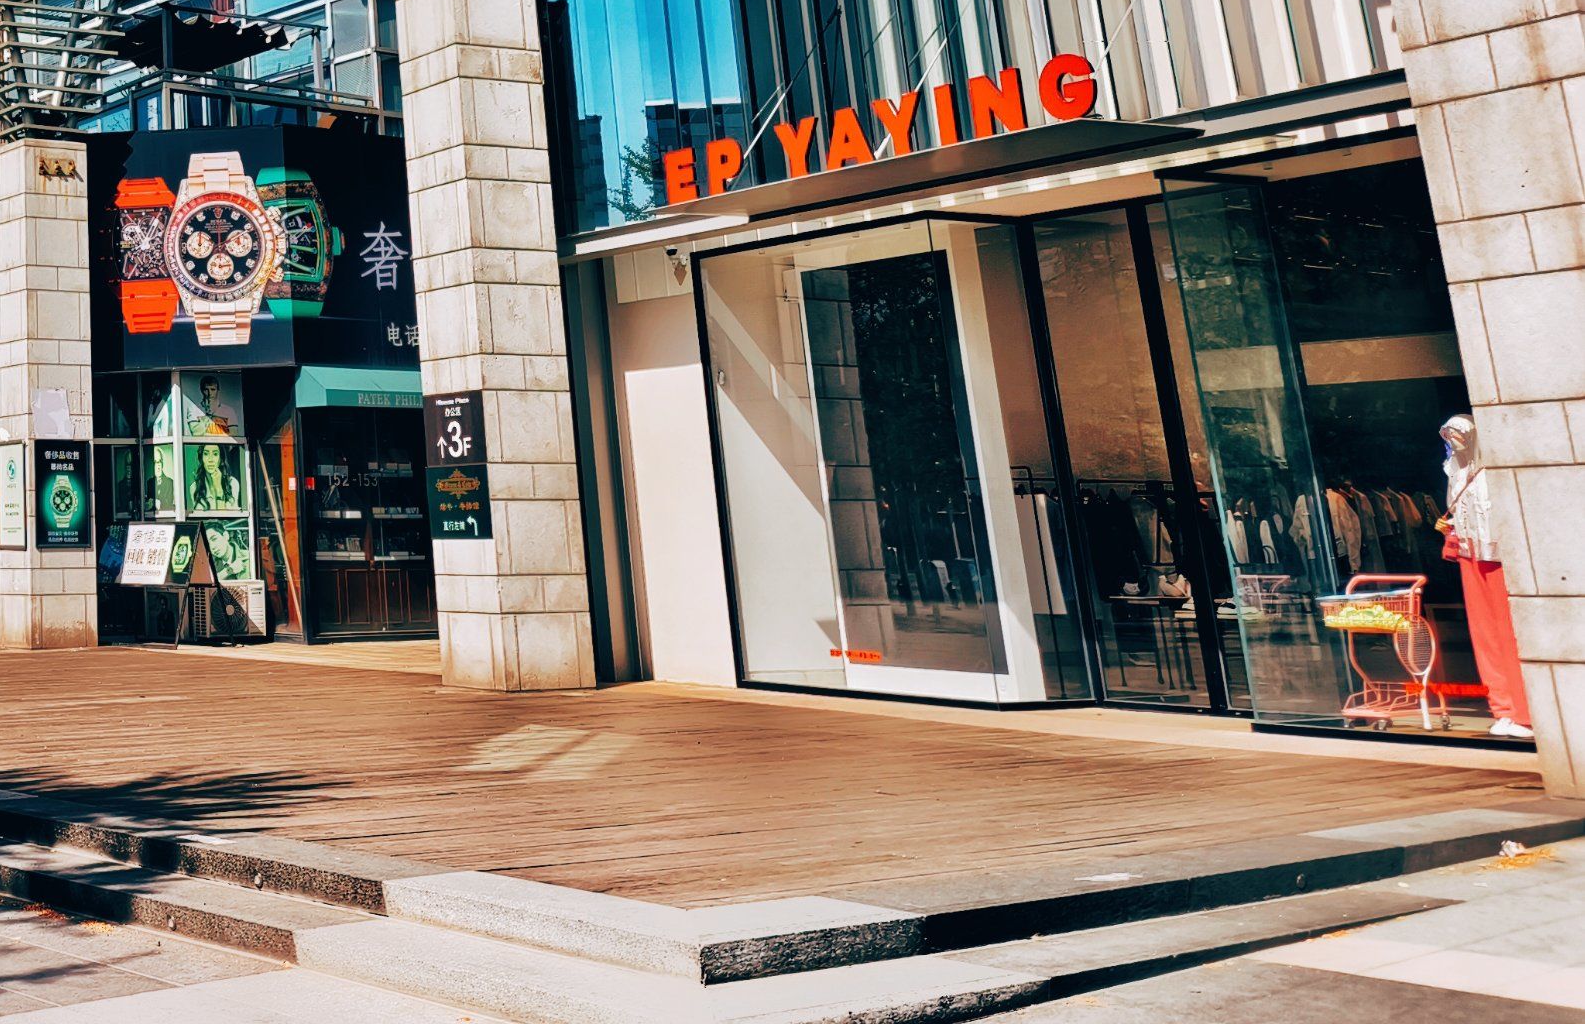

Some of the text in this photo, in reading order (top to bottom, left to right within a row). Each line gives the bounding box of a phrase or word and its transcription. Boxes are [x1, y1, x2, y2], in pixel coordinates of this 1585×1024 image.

[663, 53, 1098, 205] EP YAYING
[359, 220, 409, 291] 奢
[386, 322, 421, 348] 电话
[358, 392, 391, 406] PATEK
